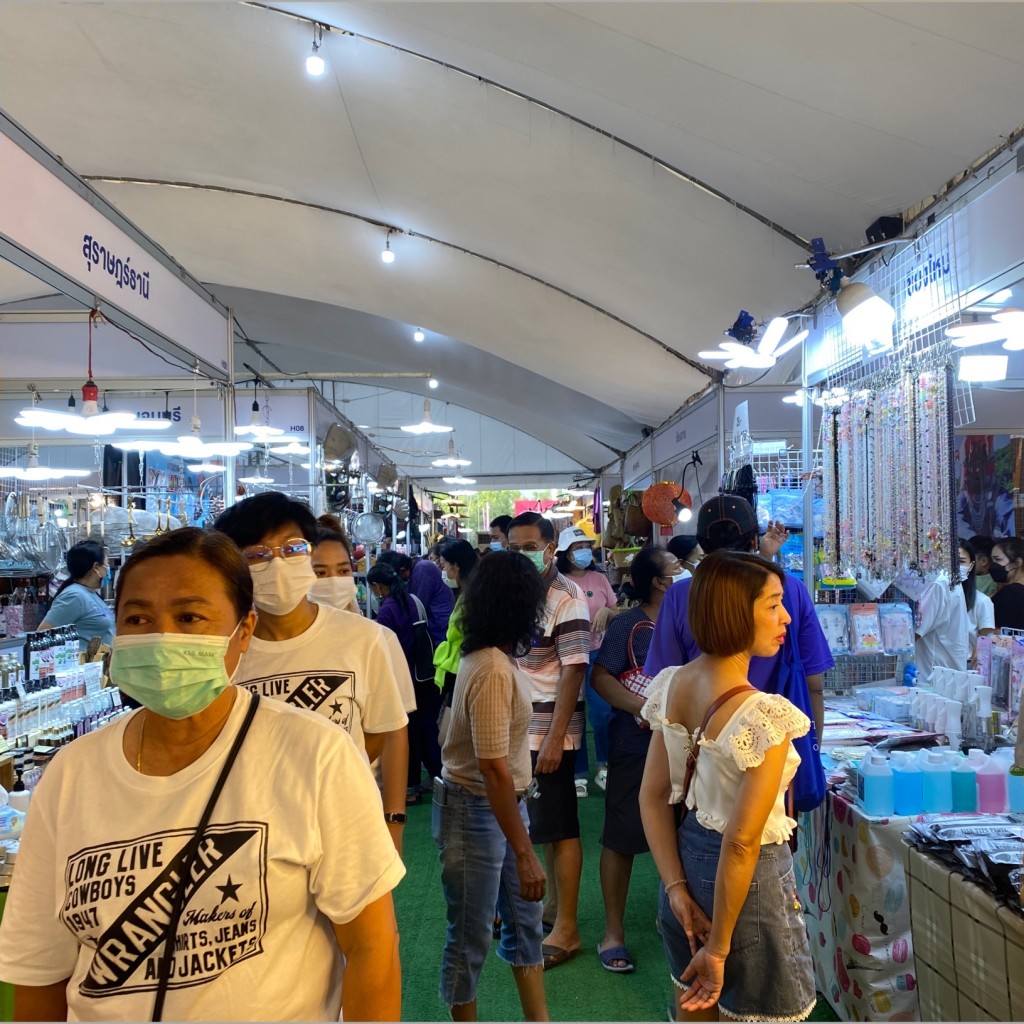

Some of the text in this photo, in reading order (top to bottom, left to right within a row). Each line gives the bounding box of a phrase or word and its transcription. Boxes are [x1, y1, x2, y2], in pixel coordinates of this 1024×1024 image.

[83, 234, 150, 300] สุราษฎร์ธานี
[262, 679, 291, 696] LIVE
[68, 841, 163, 887] LONG LIVE
[65, 875, 136, 912] COWBOYS
[66, 907, 100, 933] 1947
[183, 900, 258, 927] Makers of
[176, 919, 257, 953] HIRTS, JEANS
[144, 936, 258, 980] AD JACKETS
